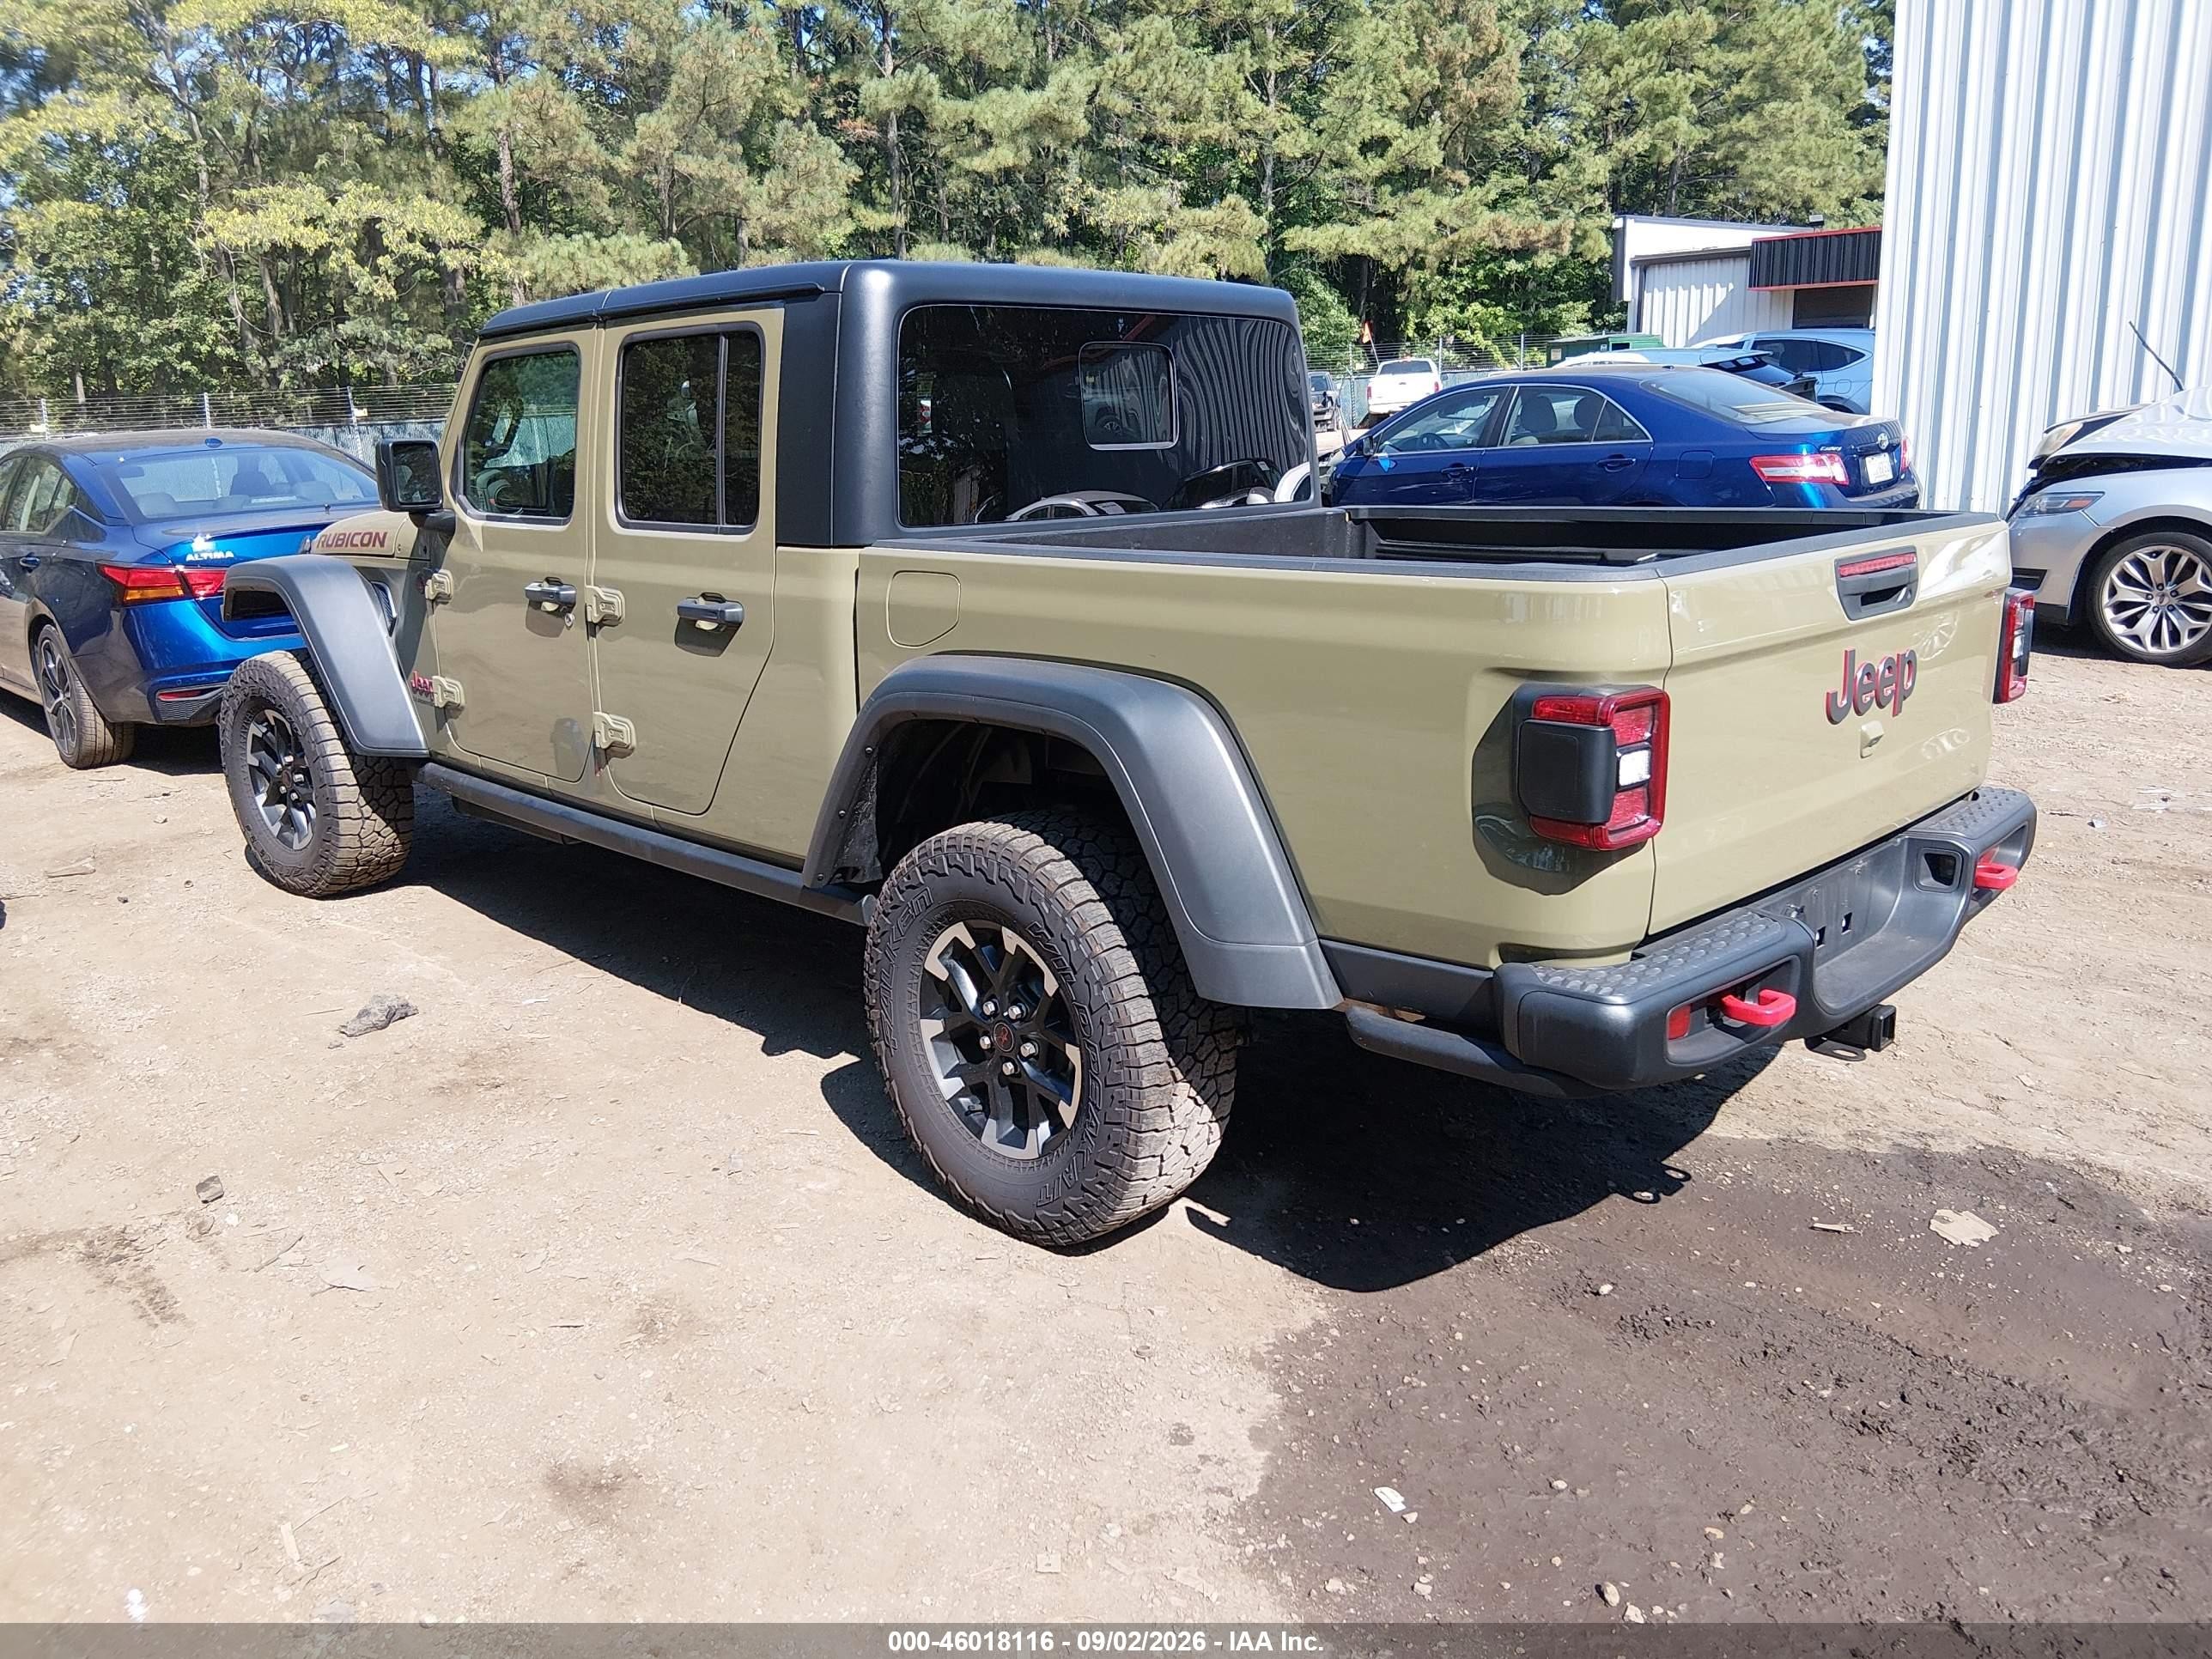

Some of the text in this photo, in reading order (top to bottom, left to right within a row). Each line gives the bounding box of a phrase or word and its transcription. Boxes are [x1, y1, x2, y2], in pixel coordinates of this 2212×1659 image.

[316, 531, 388, 549] RUBICON
[185, 550, 234, 562] ALTIMA
[1826, 648, 1917, 726] Jeep
